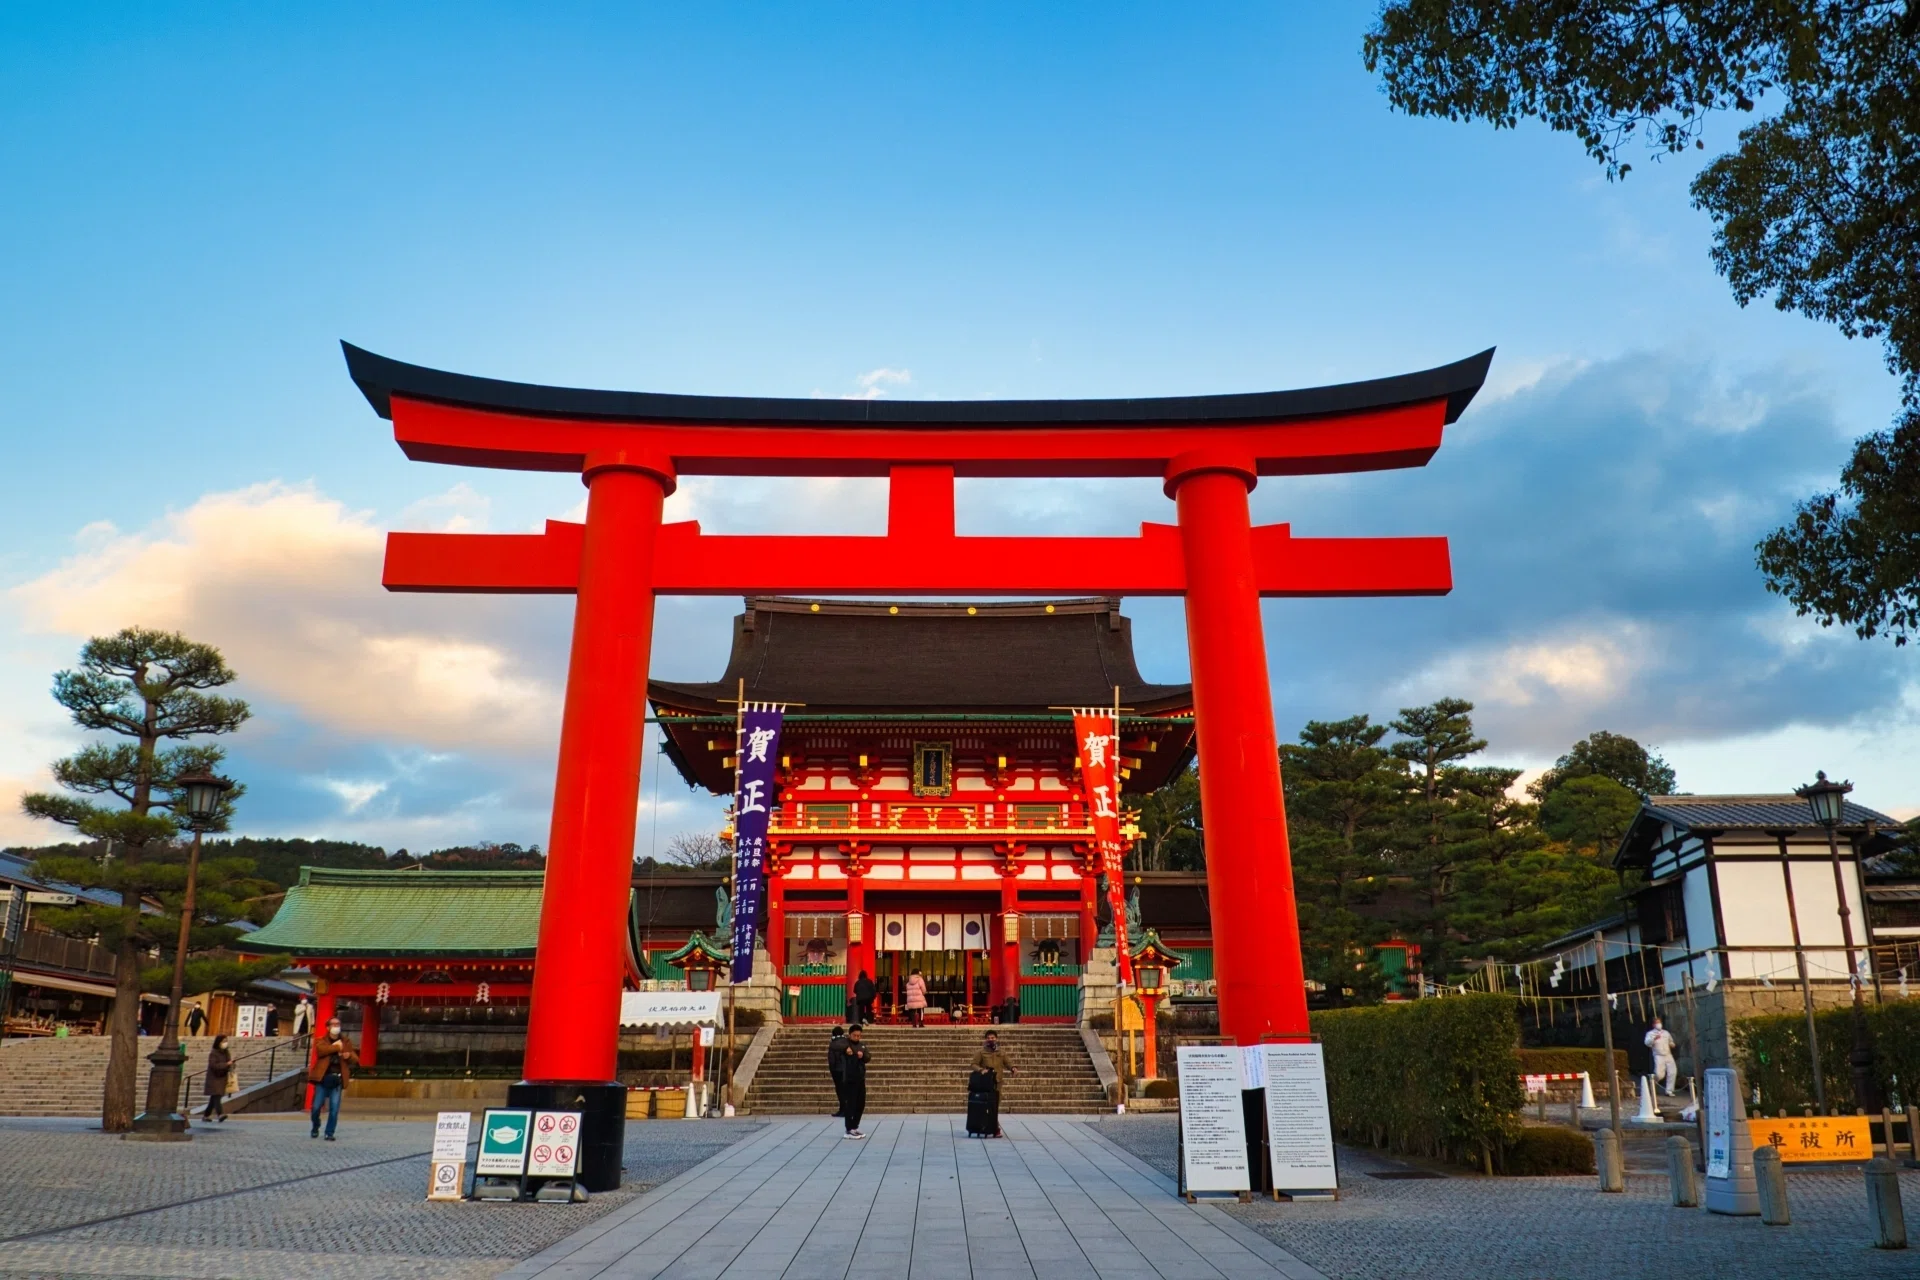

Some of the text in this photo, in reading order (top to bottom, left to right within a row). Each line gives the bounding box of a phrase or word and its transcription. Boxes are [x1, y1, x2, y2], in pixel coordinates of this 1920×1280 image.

[742, 726, 776, 815] 賀正
[1084, 731, 1117, 819] 賀正
[438, 1121, 467, 1130] 飲食禁止
